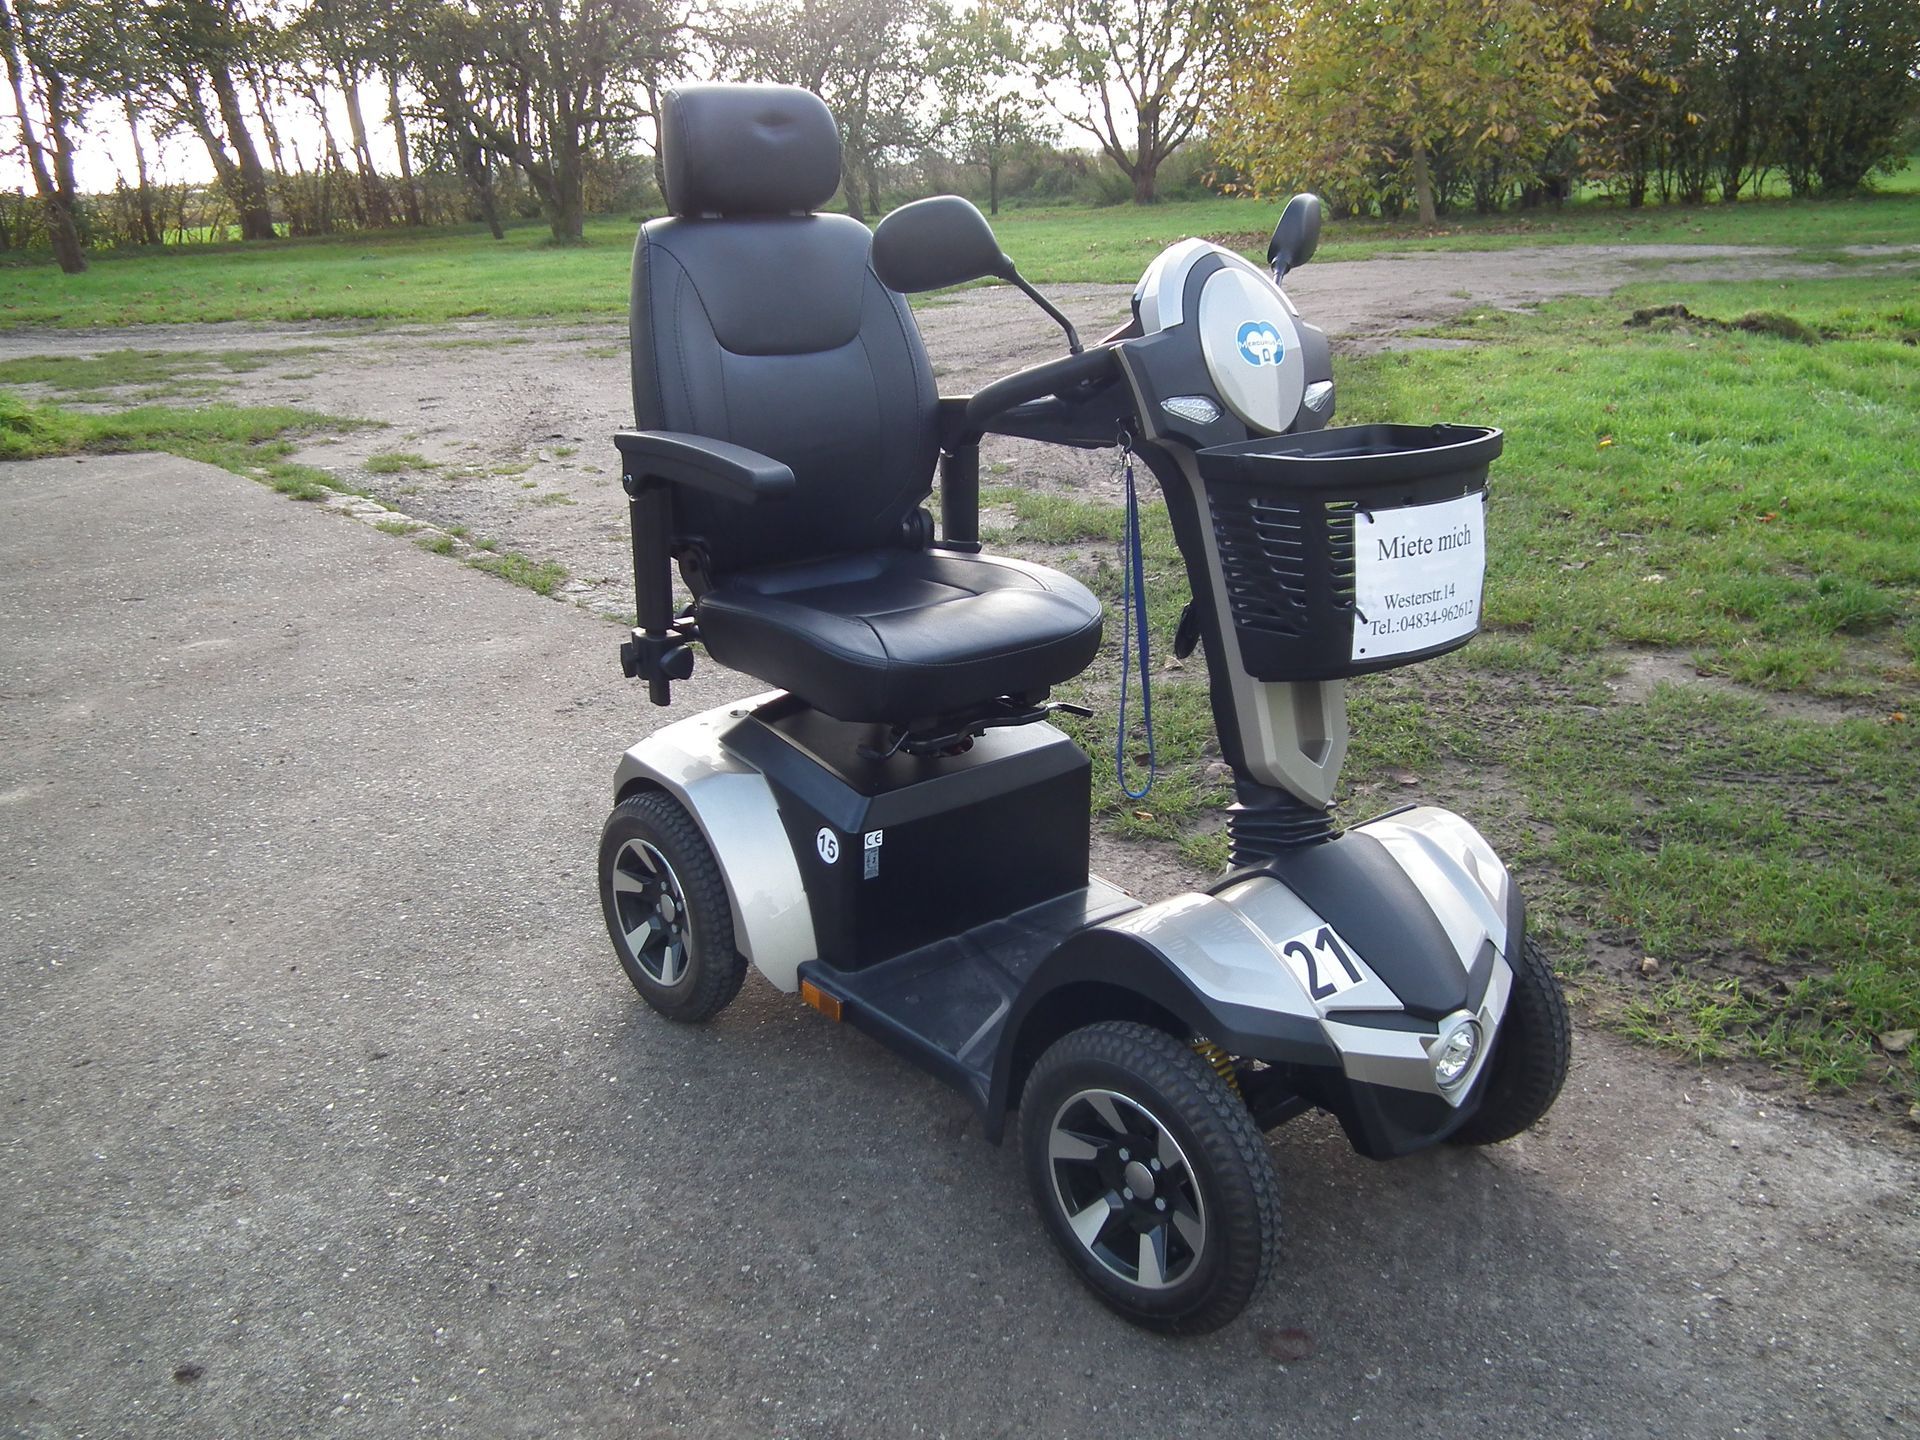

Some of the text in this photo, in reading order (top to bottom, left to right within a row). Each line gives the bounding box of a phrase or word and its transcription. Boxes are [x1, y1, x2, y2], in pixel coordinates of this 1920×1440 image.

[1377, 523, 1471, 562] Miete mich
[819, 834, 836, 859] 15
[866, 832, 882, 846] CE
[1283, 927, 1363, 1001] 21
